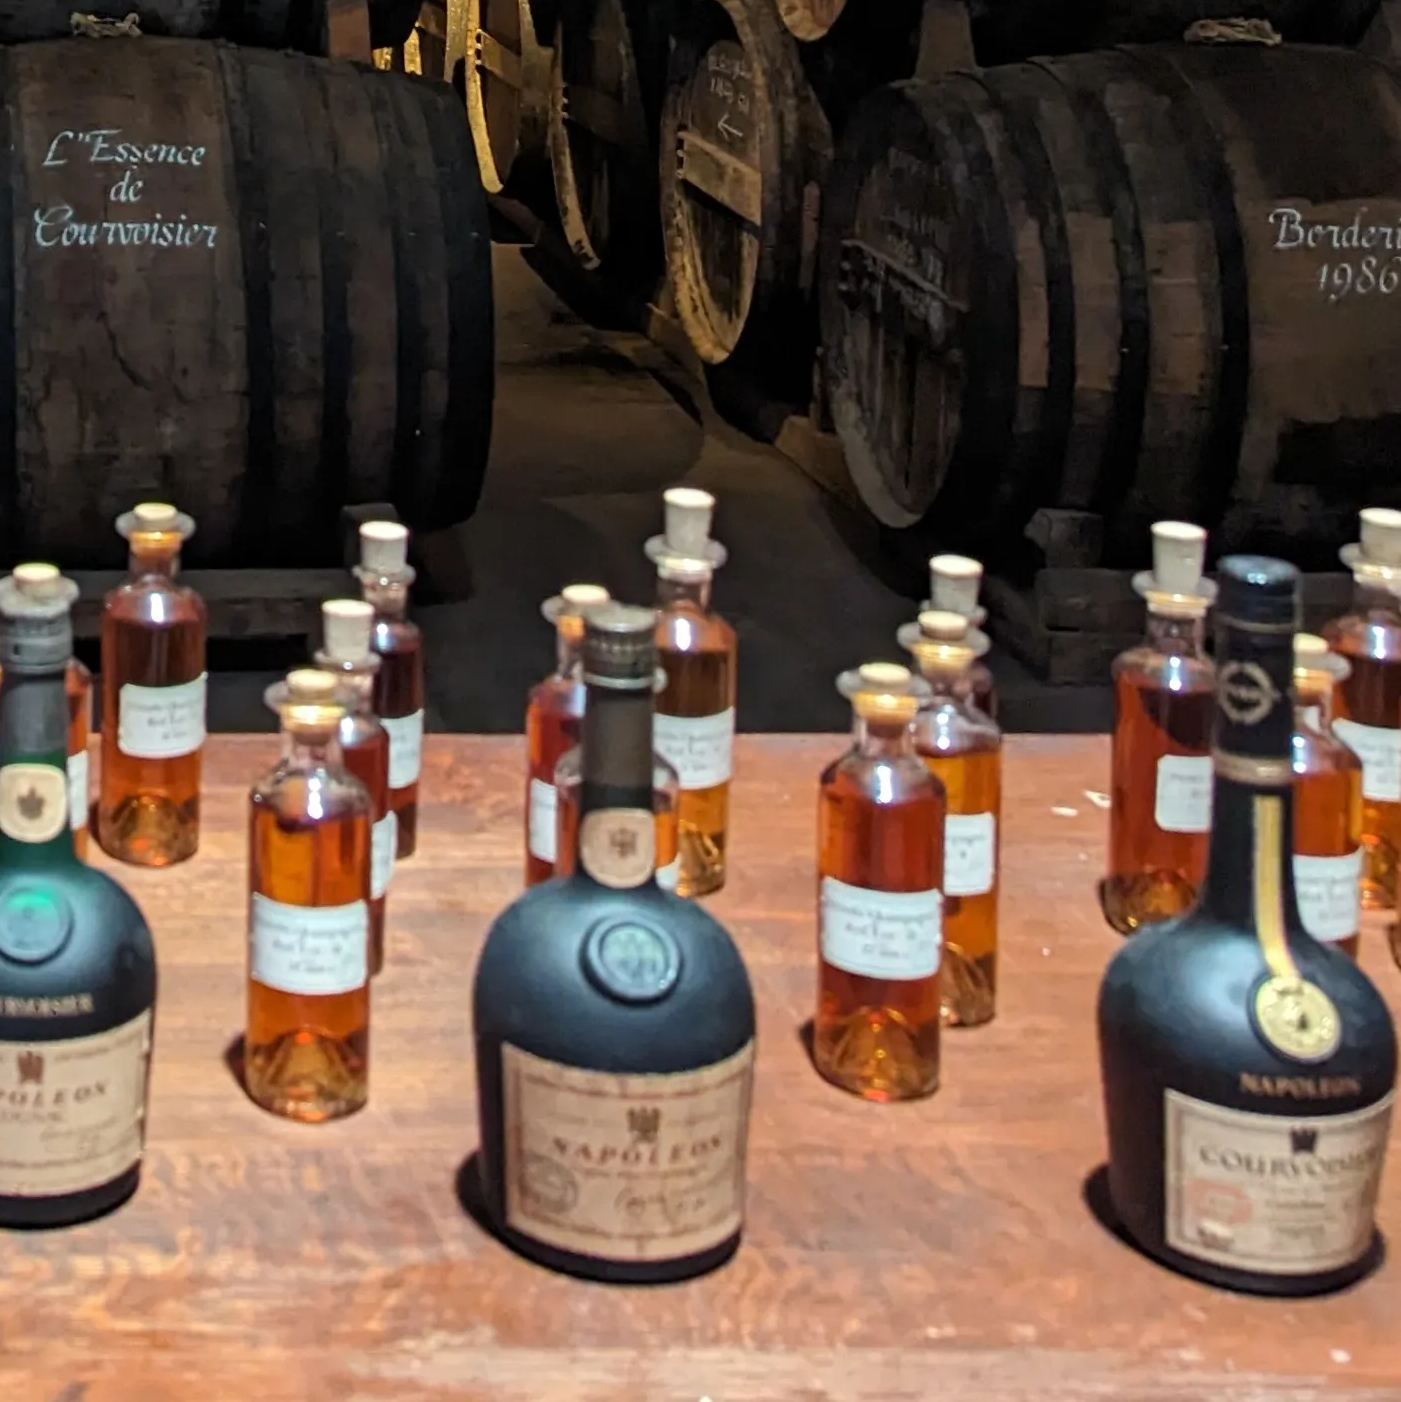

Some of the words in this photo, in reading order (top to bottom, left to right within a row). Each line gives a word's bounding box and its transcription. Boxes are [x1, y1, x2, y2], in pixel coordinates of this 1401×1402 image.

[109, 168, 144, 203] de
[34, 204, 218, 248] Courvoisier
[1318, 256, 1401, 301] 1986
